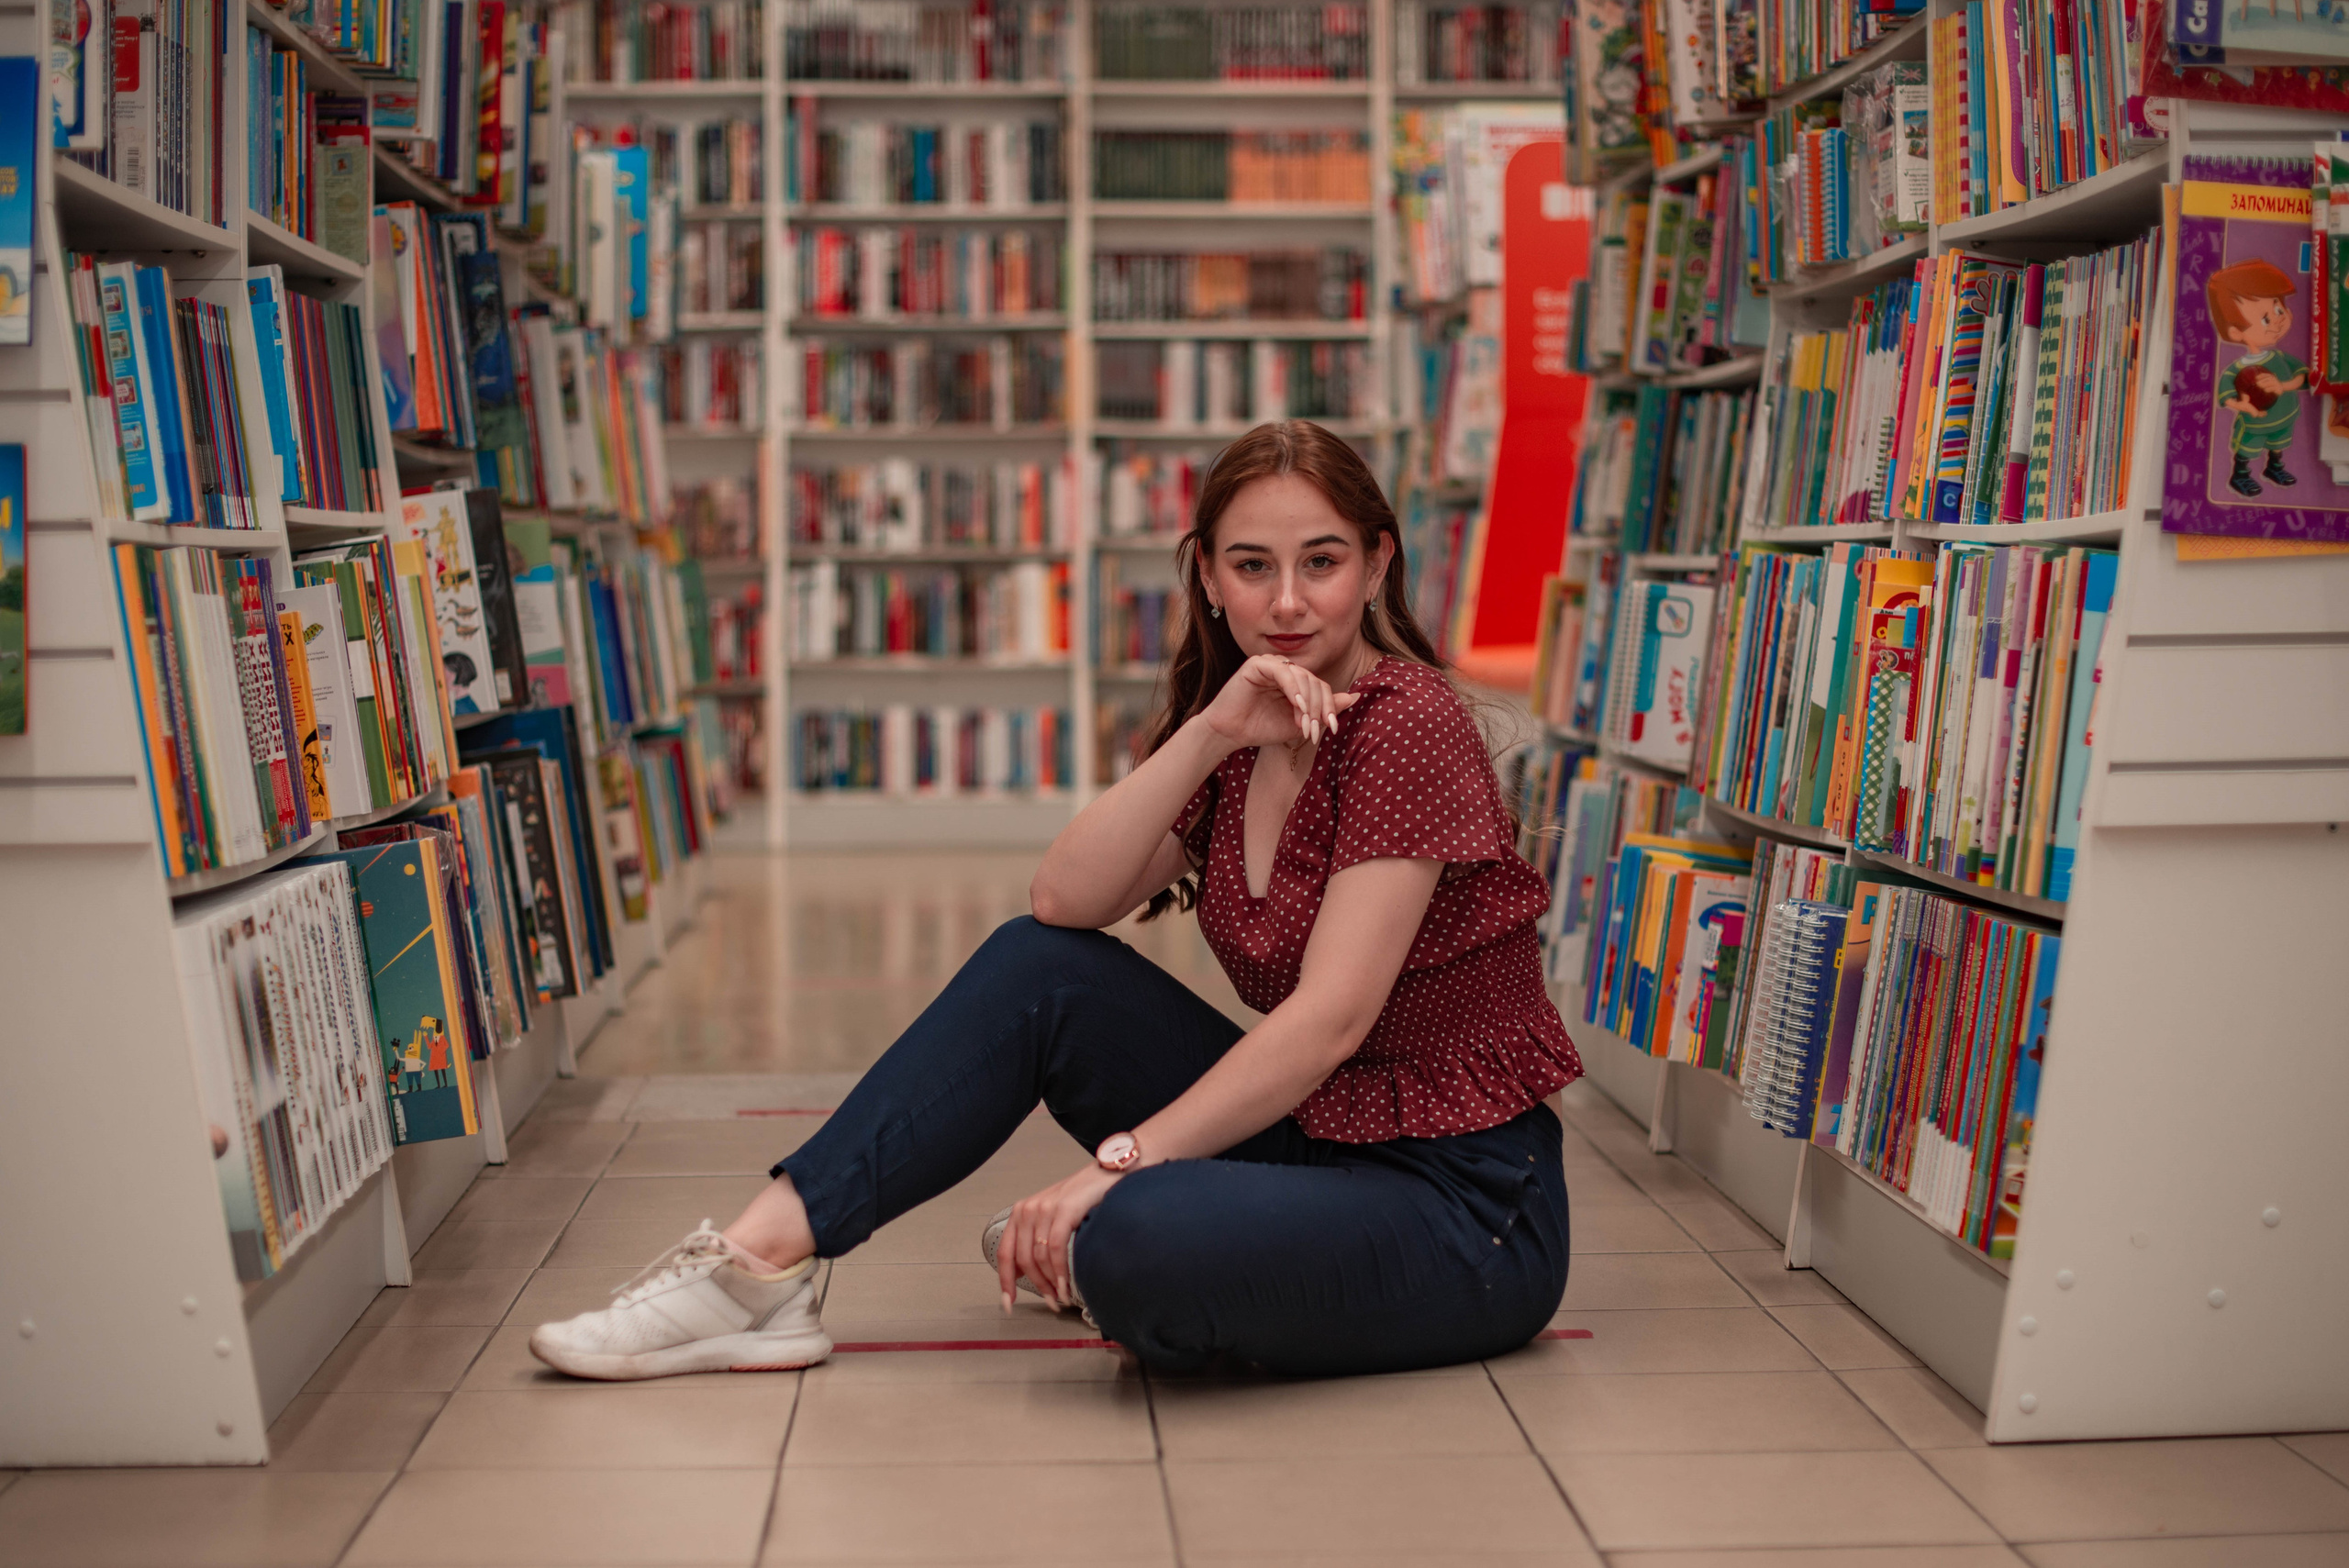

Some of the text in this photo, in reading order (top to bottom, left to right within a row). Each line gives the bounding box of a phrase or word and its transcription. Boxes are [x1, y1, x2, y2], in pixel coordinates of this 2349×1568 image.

[2231, 194, 2313, 216] ЗАПОМИНАЙ
[2331, 239, 2340, 378] МАТЕМАТИКА
[2171, 391, 2211, 408] riting
